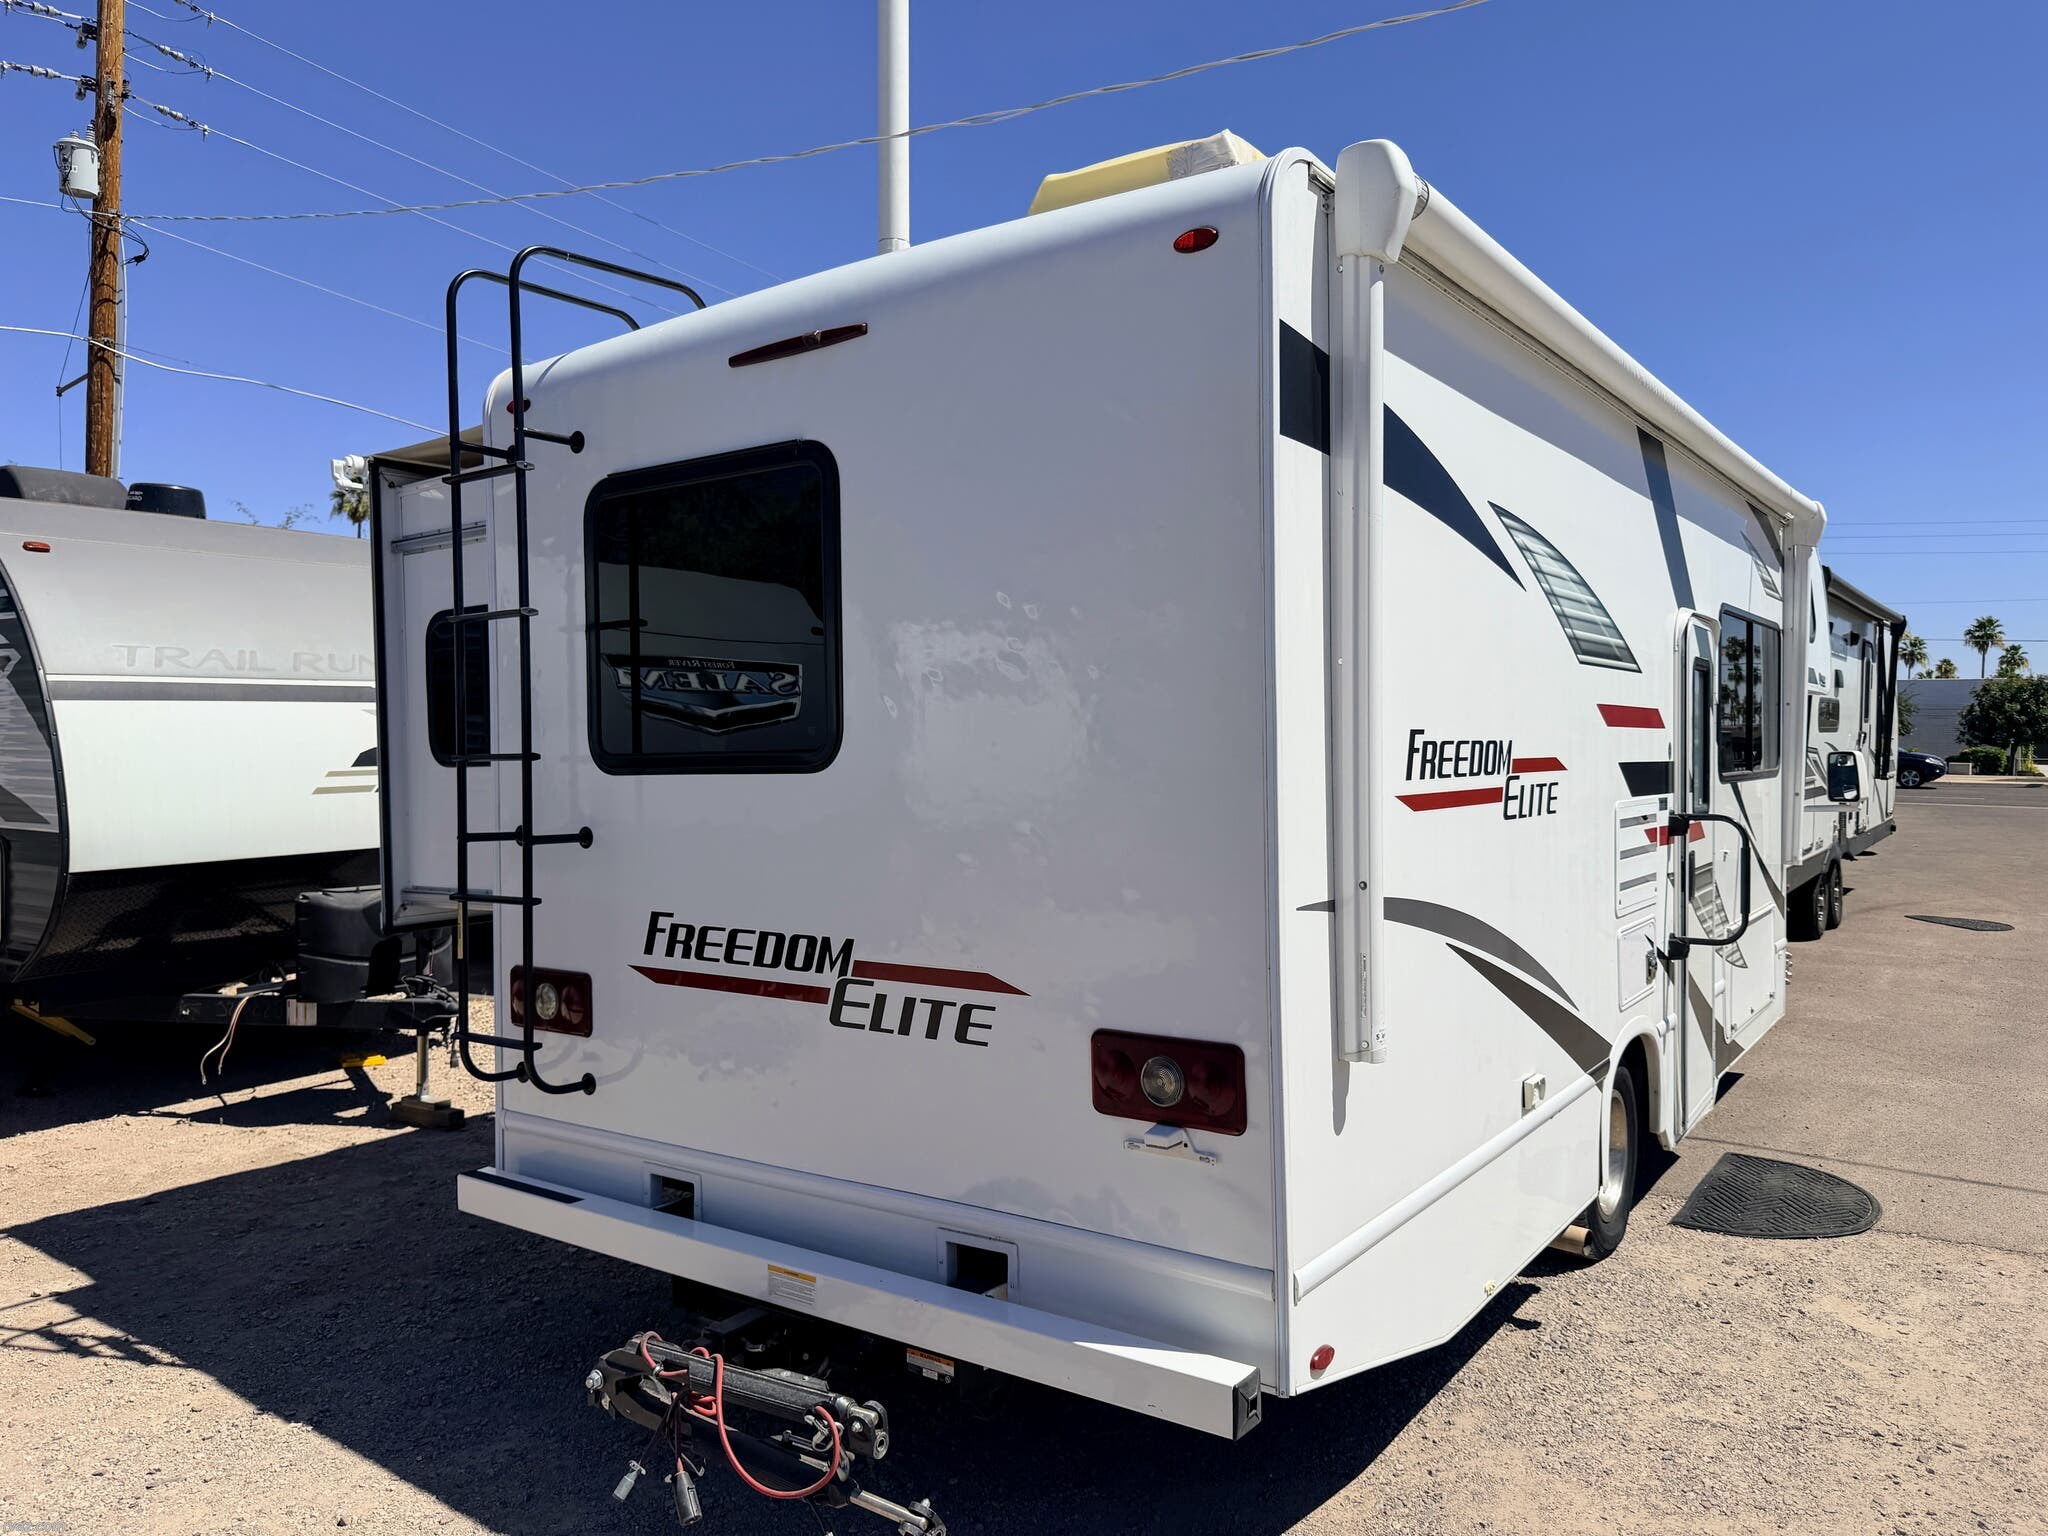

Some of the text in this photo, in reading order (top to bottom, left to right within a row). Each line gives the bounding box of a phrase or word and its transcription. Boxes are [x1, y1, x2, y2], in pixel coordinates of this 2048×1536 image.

[112, 644, 276, 673] TRAIL
[1405, 728, 1513, 782] FREEDOM
[1502, 775, 1559, 820] ELITE
[643, 910, 855, 978] FREEDOM
[828, 977, 997, 1048] ELITE
